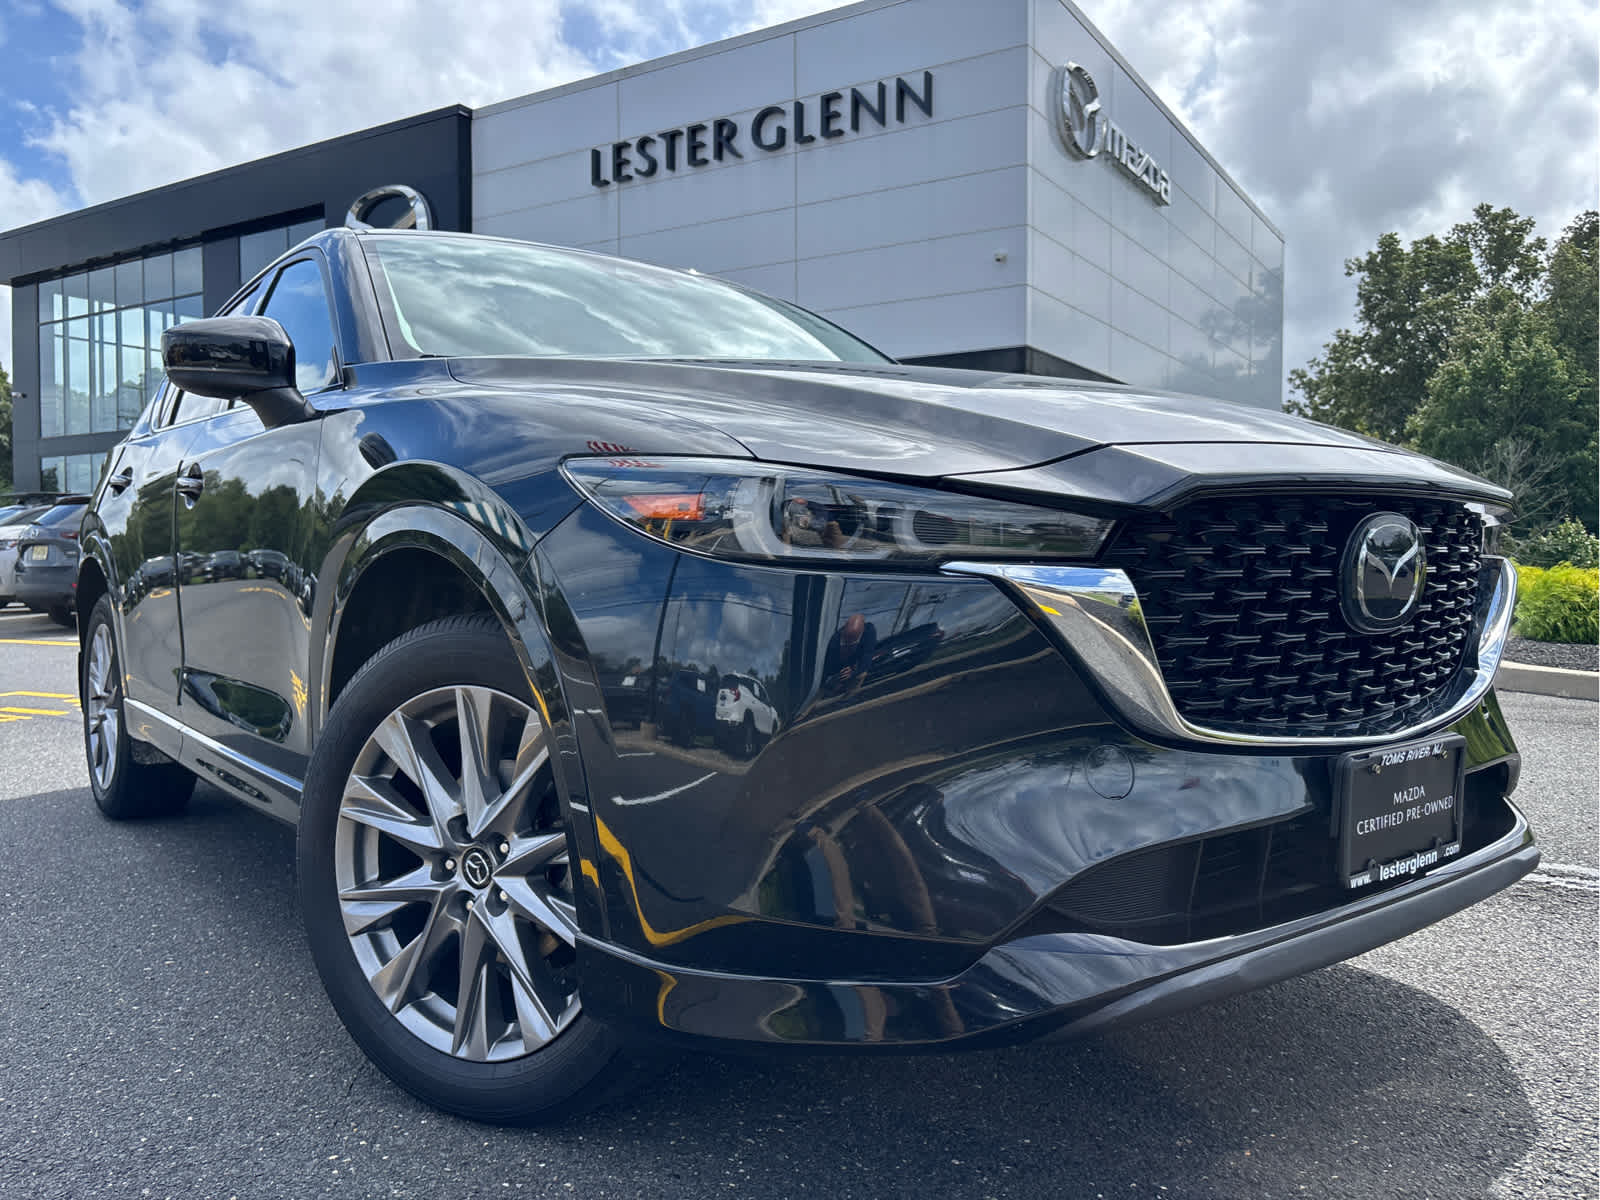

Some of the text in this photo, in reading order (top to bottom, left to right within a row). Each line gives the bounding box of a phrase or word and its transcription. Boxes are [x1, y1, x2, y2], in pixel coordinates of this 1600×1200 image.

[591, 71, 934, 188] LESTER GLENN
[1102, 118, 1172, 206] mazda
[1381, 752, 1405, 766] TOMS
[1393, 784, 1425, 805] MAZDA
[1356, 795, 1453, 835] CERTIFIED PRE-OWNED
